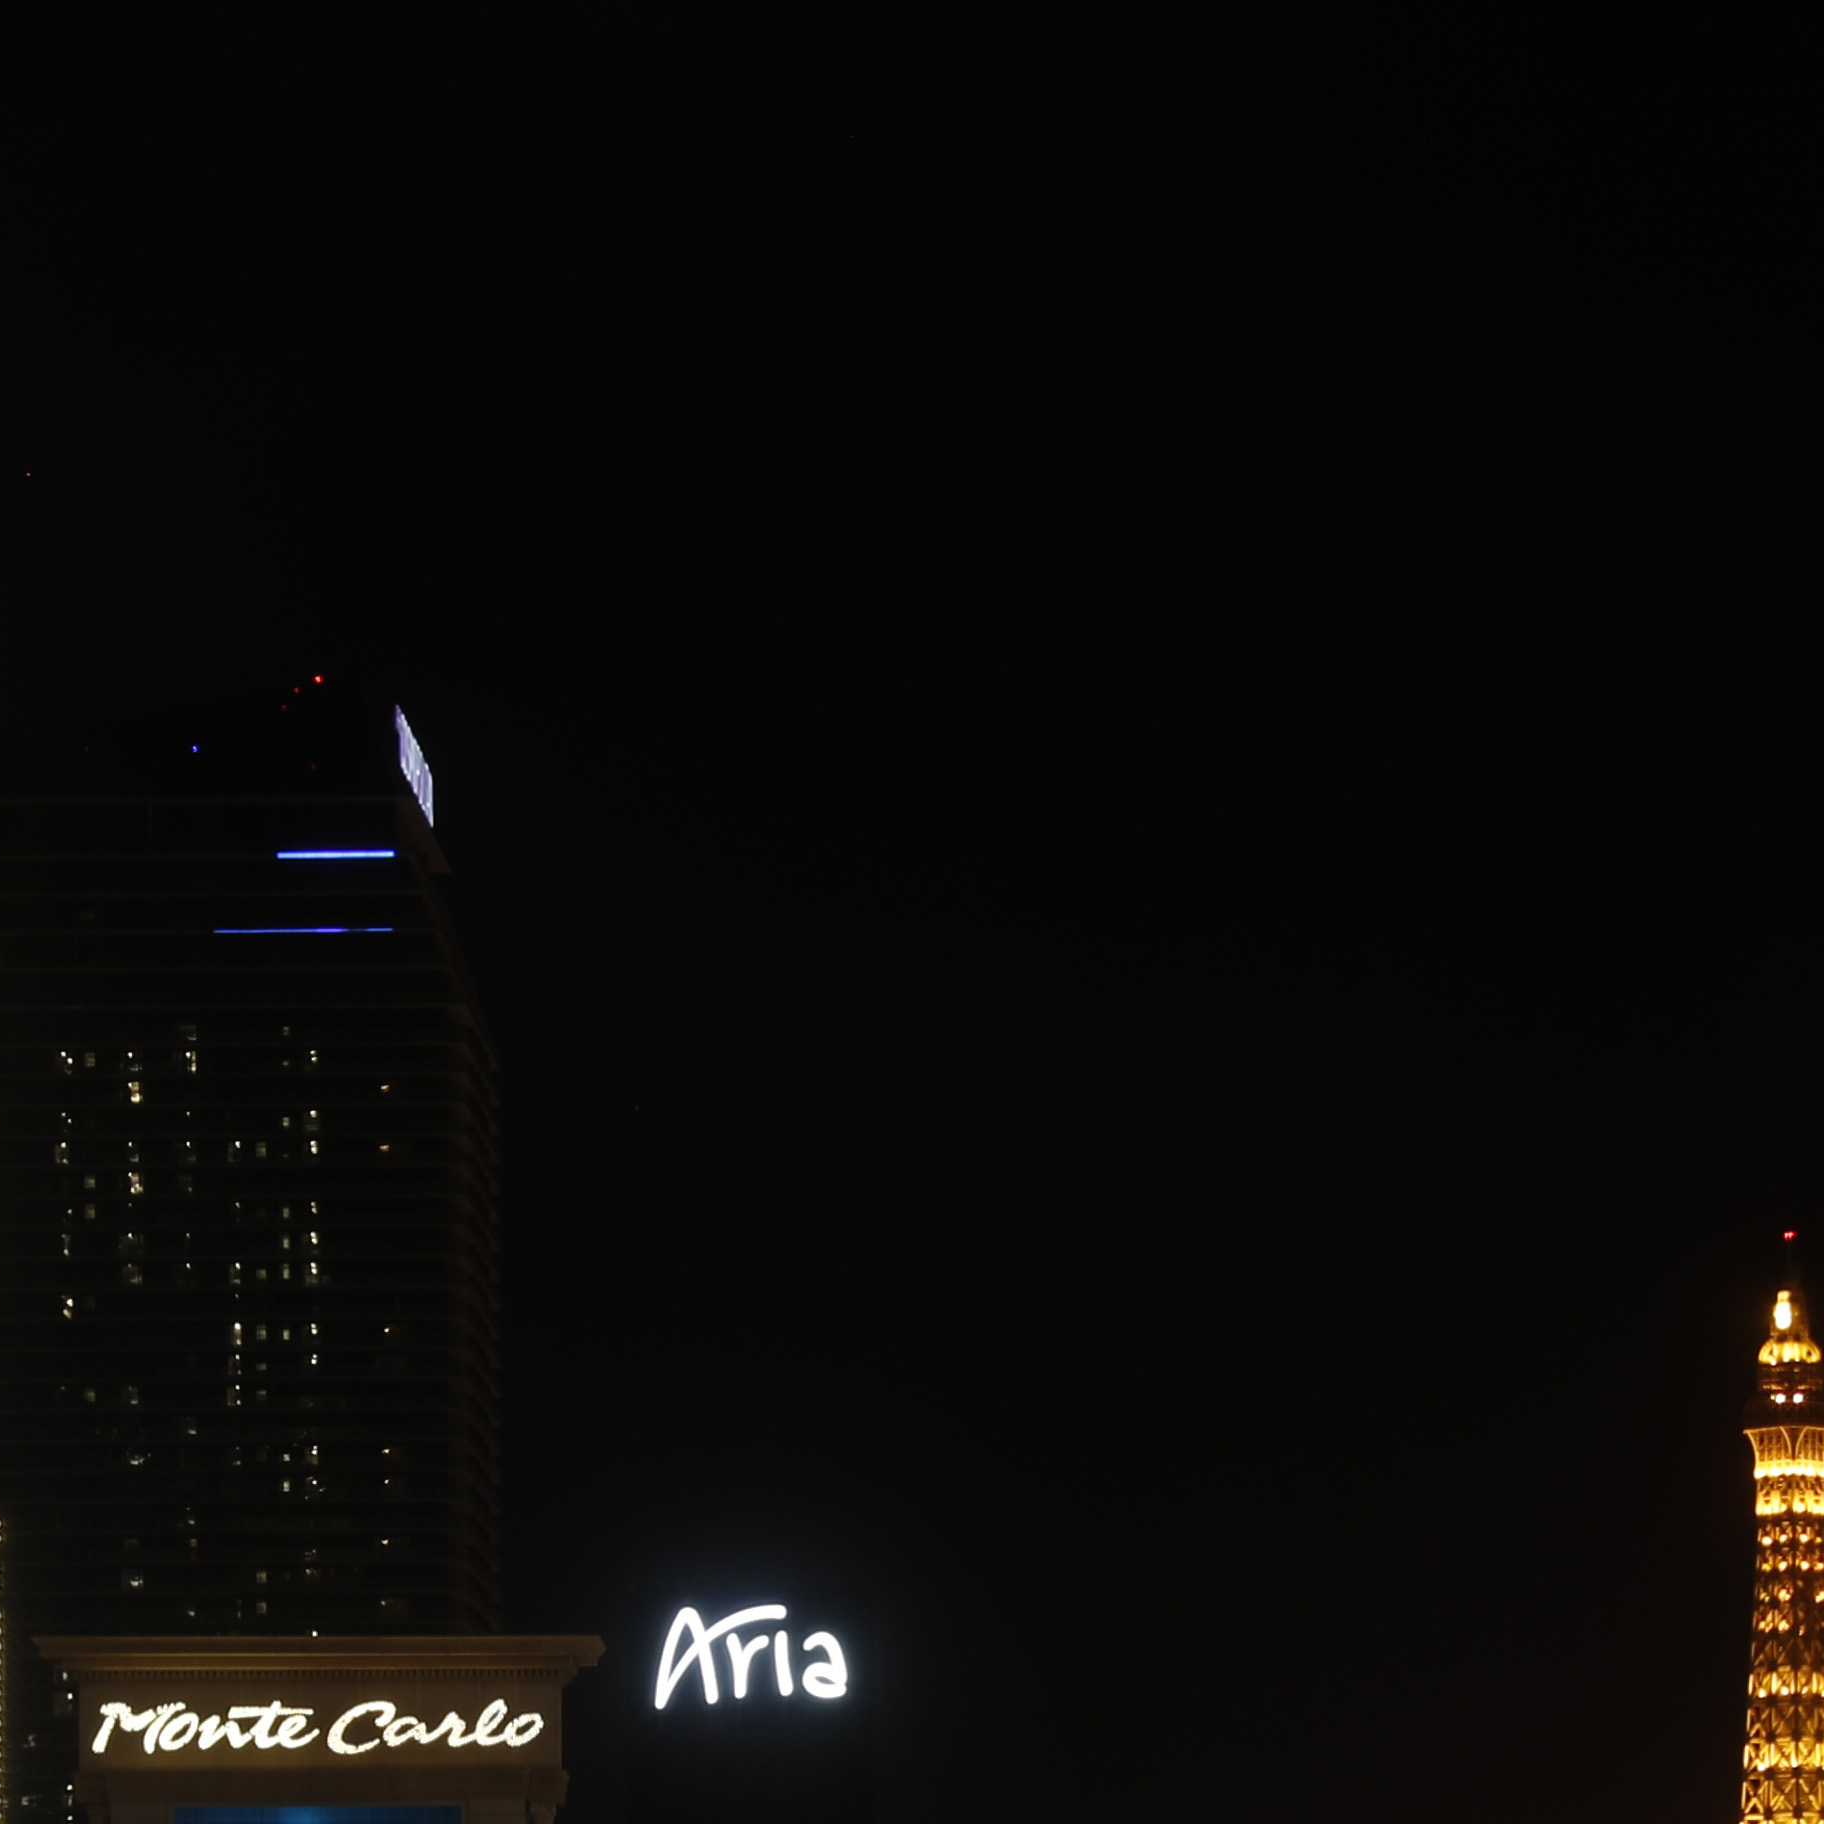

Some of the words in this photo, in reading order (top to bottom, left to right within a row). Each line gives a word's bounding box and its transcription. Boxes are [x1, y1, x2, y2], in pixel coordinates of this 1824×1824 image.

[654, 1604, 849, 1711] Aria
[90, 1698, 320, 1755] Monte
[327, 1697, 546, 1756] Carlo
